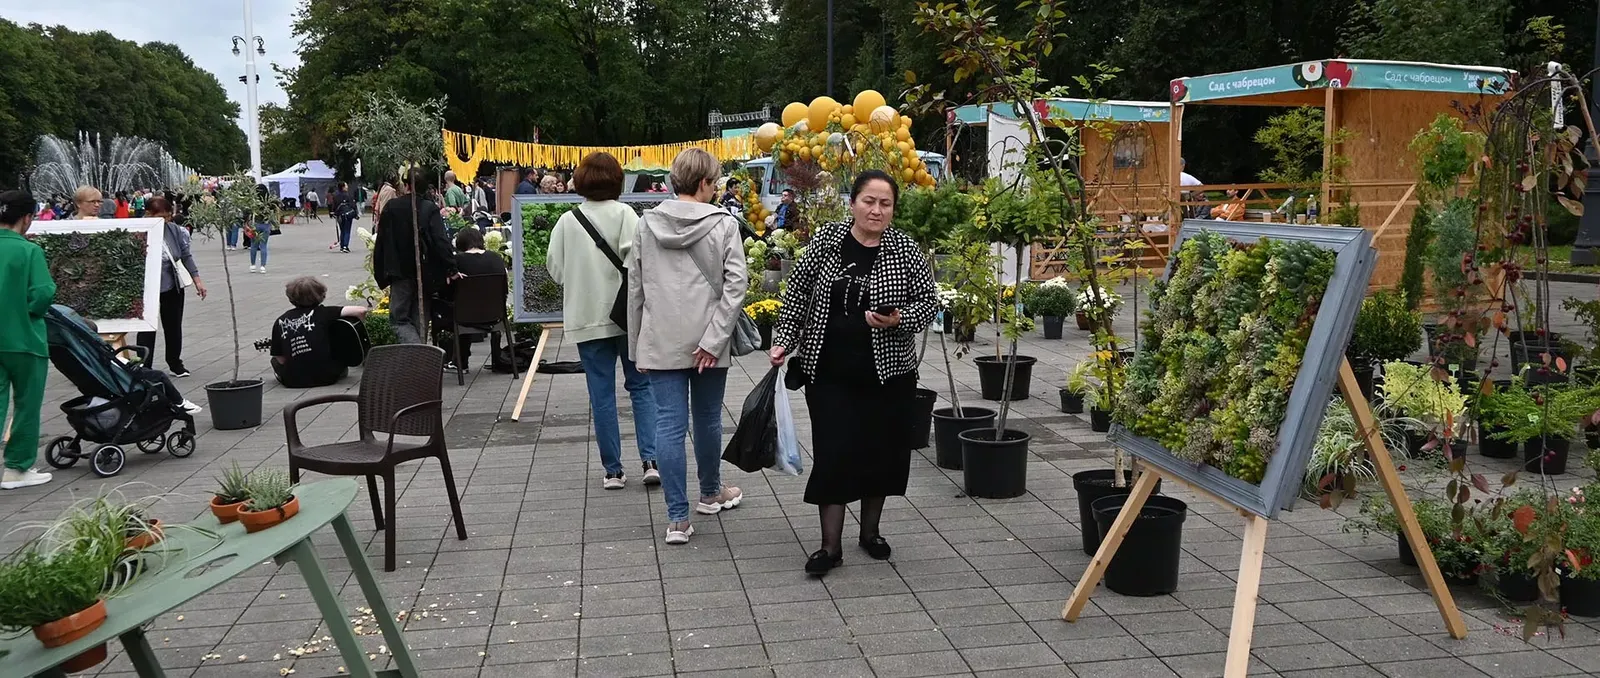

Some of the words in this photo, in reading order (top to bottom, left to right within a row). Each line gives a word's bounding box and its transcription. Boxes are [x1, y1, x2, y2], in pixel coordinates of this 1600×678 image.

[1208, 81, 1225, 92] Сад
[1226, 82, 1231, 90] с
[1232, 76, 1276, 90] чабрецом
[1384, 70, 1402, 83] Сад
[1403, 74, 1408, 82] с
[1410, 72, 1452, 84] чабрецом
